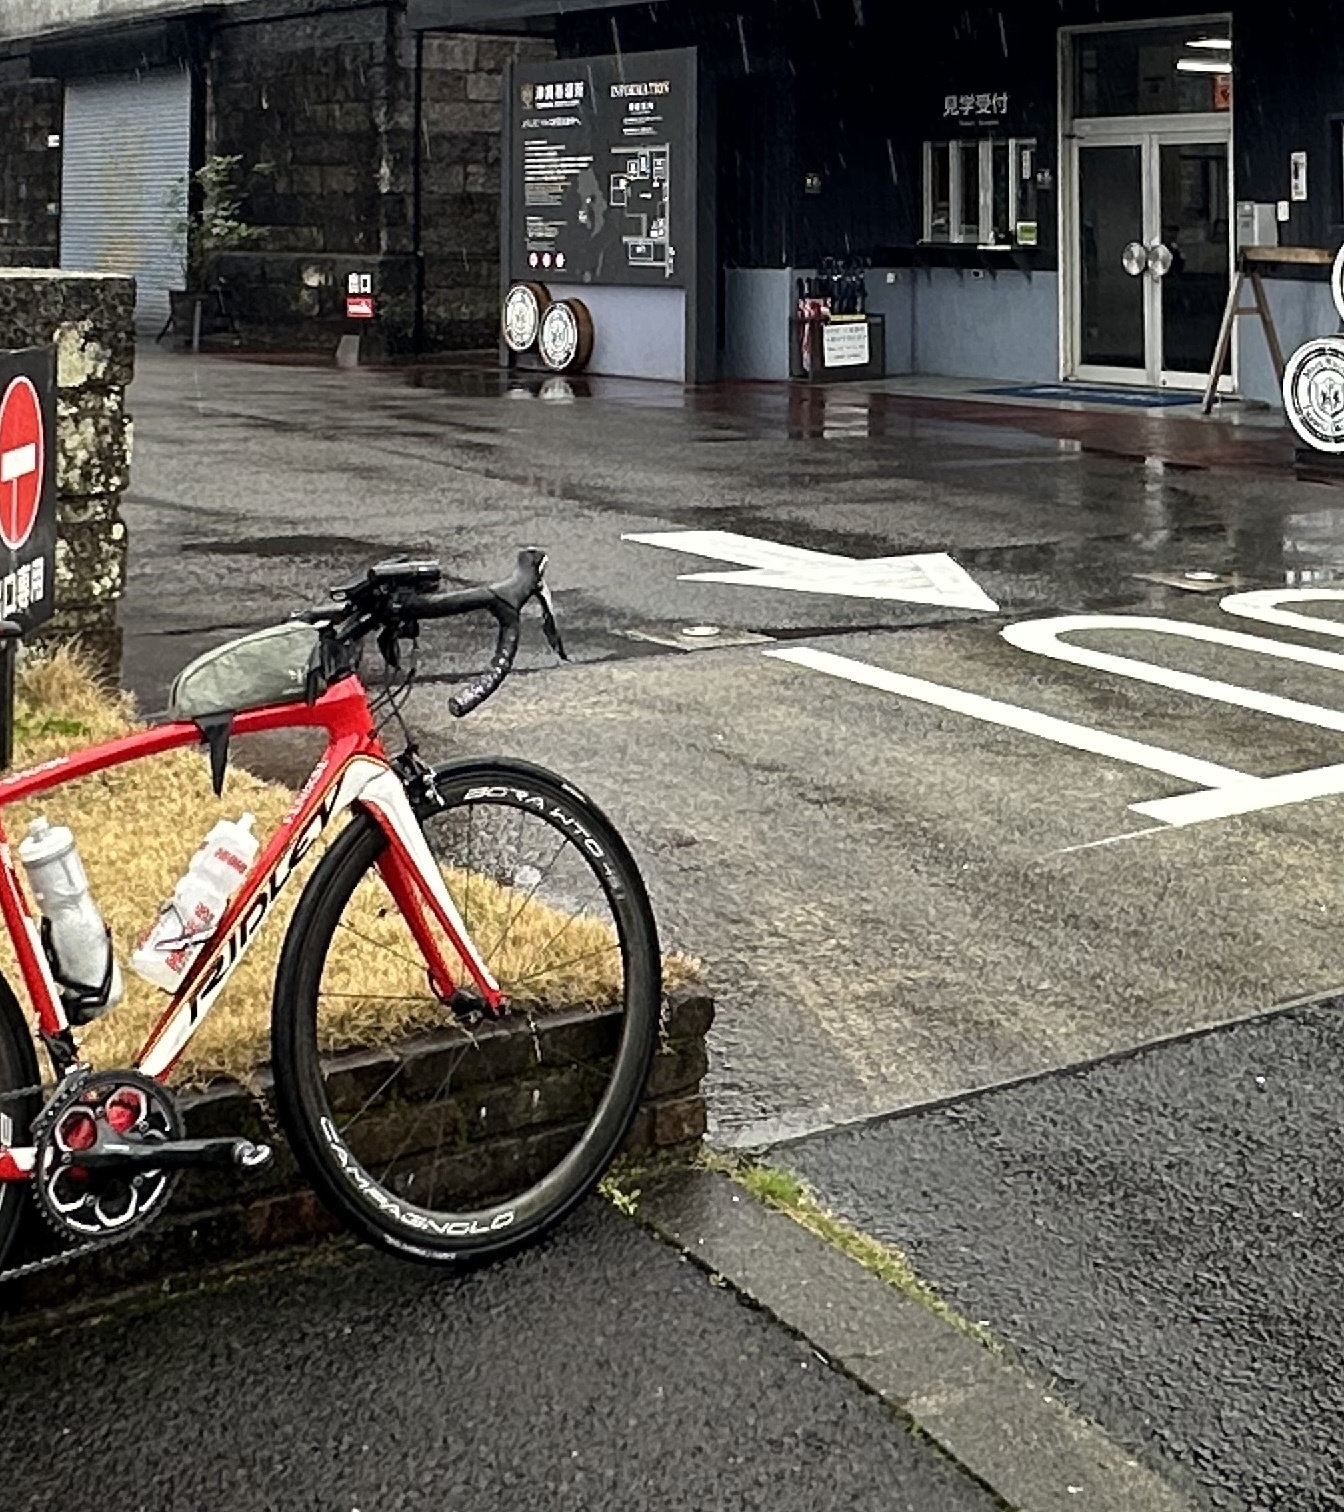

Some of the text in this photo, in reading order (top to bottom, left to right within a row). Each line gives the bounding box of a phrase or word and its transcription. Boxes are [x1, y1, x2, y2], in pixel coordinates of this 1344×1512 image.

[942, 91, 1008, 117] 見学受付
[462, 786, 544, 810] BORA
[319, 1115, 516, 1236] CAMPAGNOLO
